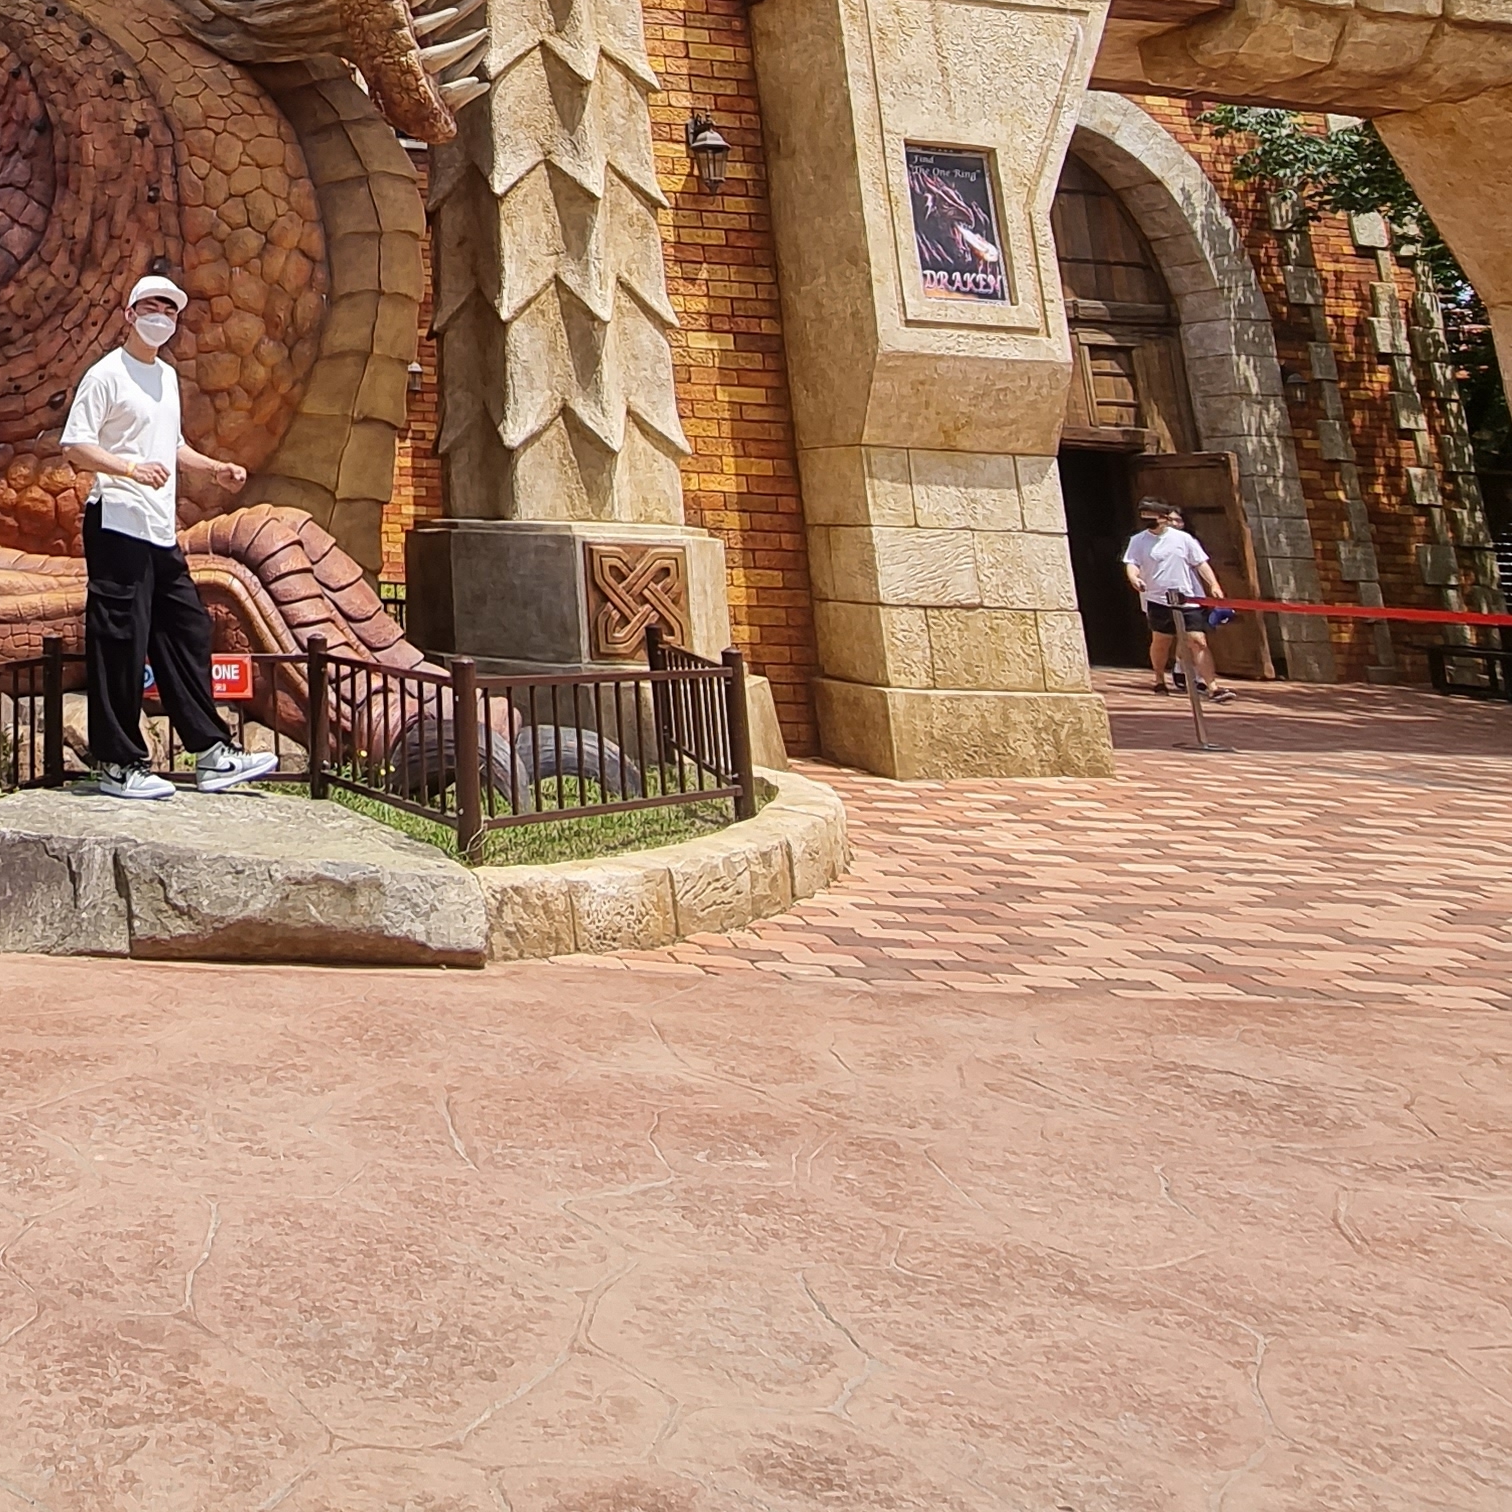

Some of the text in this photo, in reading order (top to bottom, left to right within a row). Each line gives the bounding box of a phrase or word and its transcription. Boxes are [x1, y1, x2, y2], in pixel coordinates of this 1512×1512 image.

[932, 167, 951, 177] One
[922, 269, 1002, 299] DRAKEN
[211, 664, 240, 680] ONE
